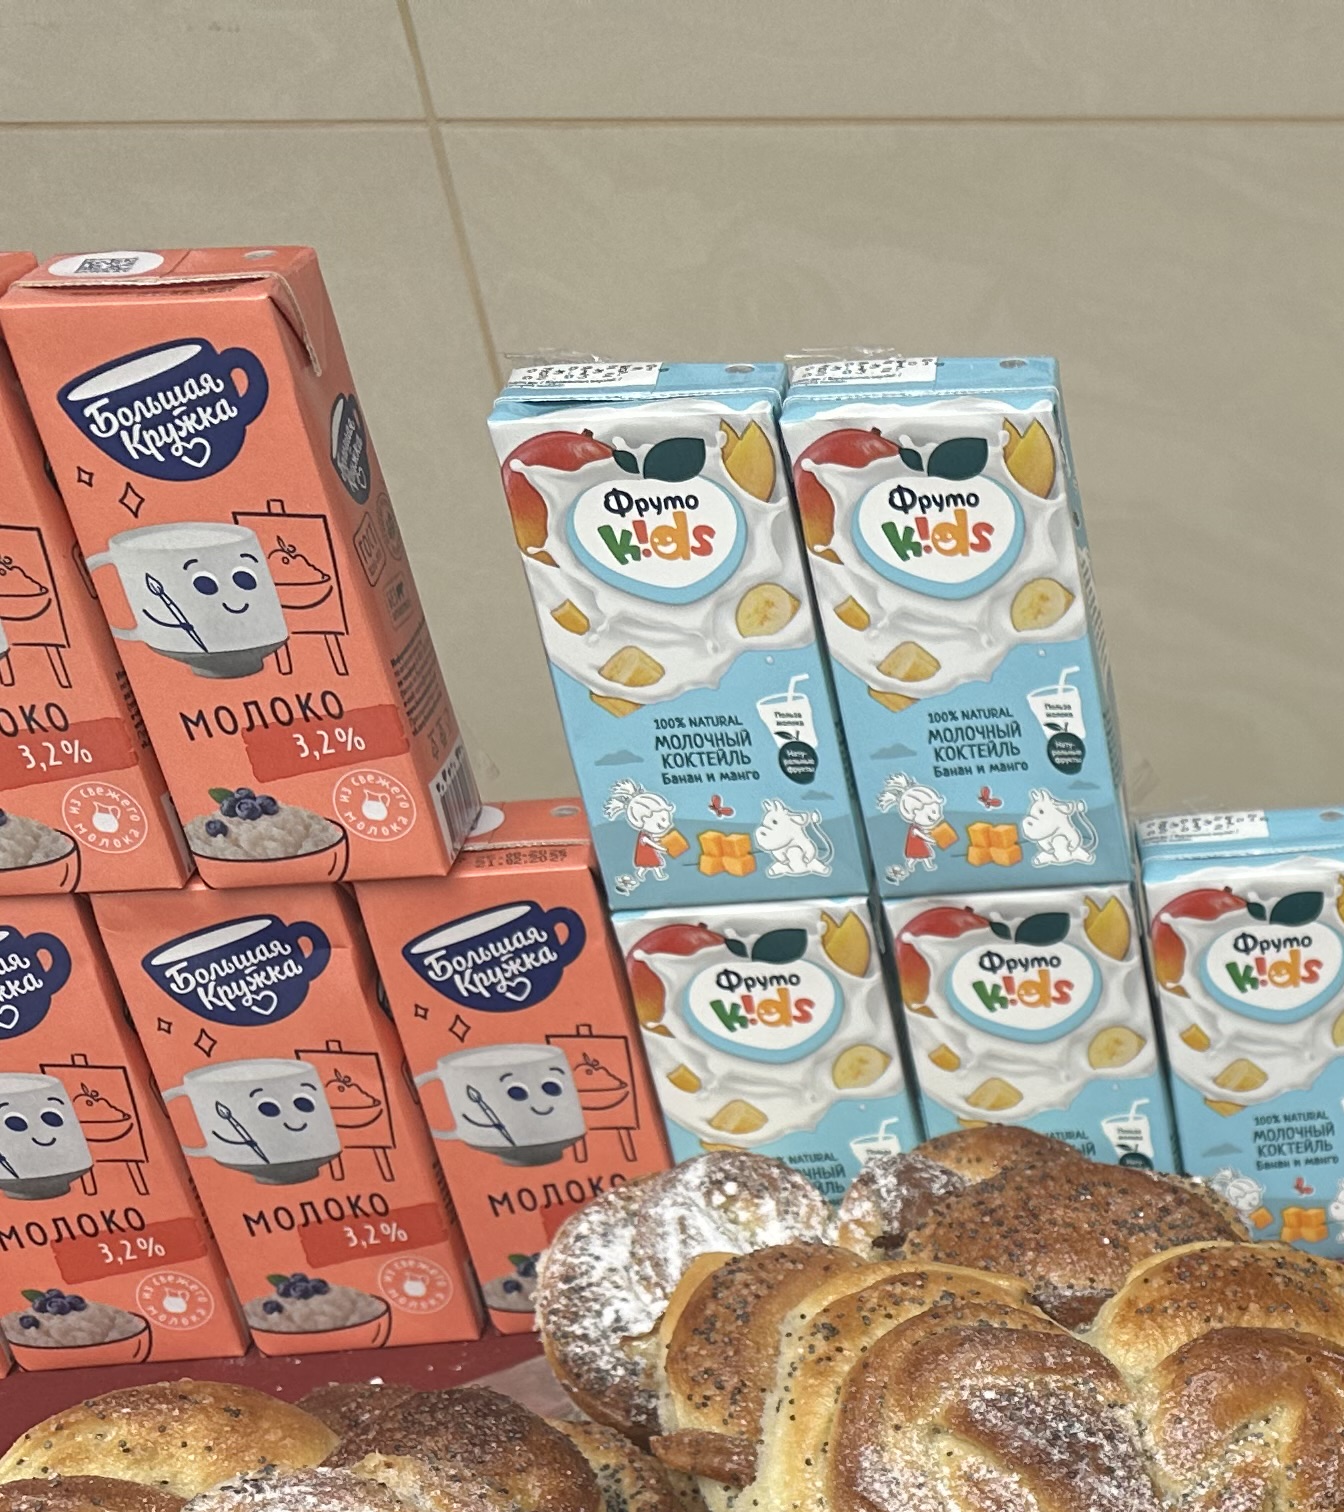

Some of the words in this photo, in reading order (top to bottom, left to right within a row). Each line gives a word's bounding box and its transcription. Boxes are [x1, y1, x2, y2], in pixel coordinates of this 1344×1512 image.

[83, 373, 225, 438] Большая
[119, 398, 239, 463] Кружка
[603, 487, 700, 518] Фруто
[888, 484, 980, 515] Фруто
[0, 702, 70, 738] ОКО
[179, 690, 345, 741] МОЛОКО
[653, 716, 687, 730] 100%
[688, 715, 744, 728] NATURAL
[927, 710, 959, 724] 100%
[961, 707, 1014, 721] NATURAL
[292, 727, 366, 760] 3,2%
[654, 729, 753, 751] МОЛОЧНЫЙ
[927, 720, 1023, 745] МОЛОЧНЫЙ
[18, 739, 93, 772] 3,2%
[661, 749, 752, 769] КОКТЕЙЛЬ
[933, 740, 1022, 763] КОКТЕЙЛЬ
[661, 772, 703, 785] Банан
[706, 773, 716, 782] и
[719, 770, 761, 782] манго
[932, 764, 974, 778] Банан
[976, 765, 986, 775] и
[989, 761, 1029, 773] манго
[423, 926, 549, 981] Большая
[1232, 932, 1313, 956] Фруто
[164, 940, 292, 994] Большая
[453, 946, 559, 998] Кружка
[978, 950, 1061, 974] Фруто
[197, 958, 304, 1012] Кружка
[716, 968, 801, 993] Фруто
[1283, 1110, 1330, 1122] NATURAL
[1252, 1121, 1336, 1143] МОЛОЧНЫЙ
[788, 1152, 840, 1164] NATURAL
[1257, 1139, 1334, 1158] КОКТЕЙЛЬ
[242, 1193, 390, 1237] МОЛОКО
[0, 1207, 146, 1251] МОЛОКО
[343, 1222, 409, 1249] 3,2%
[97, 1236, 167, 1266] 3,2%
